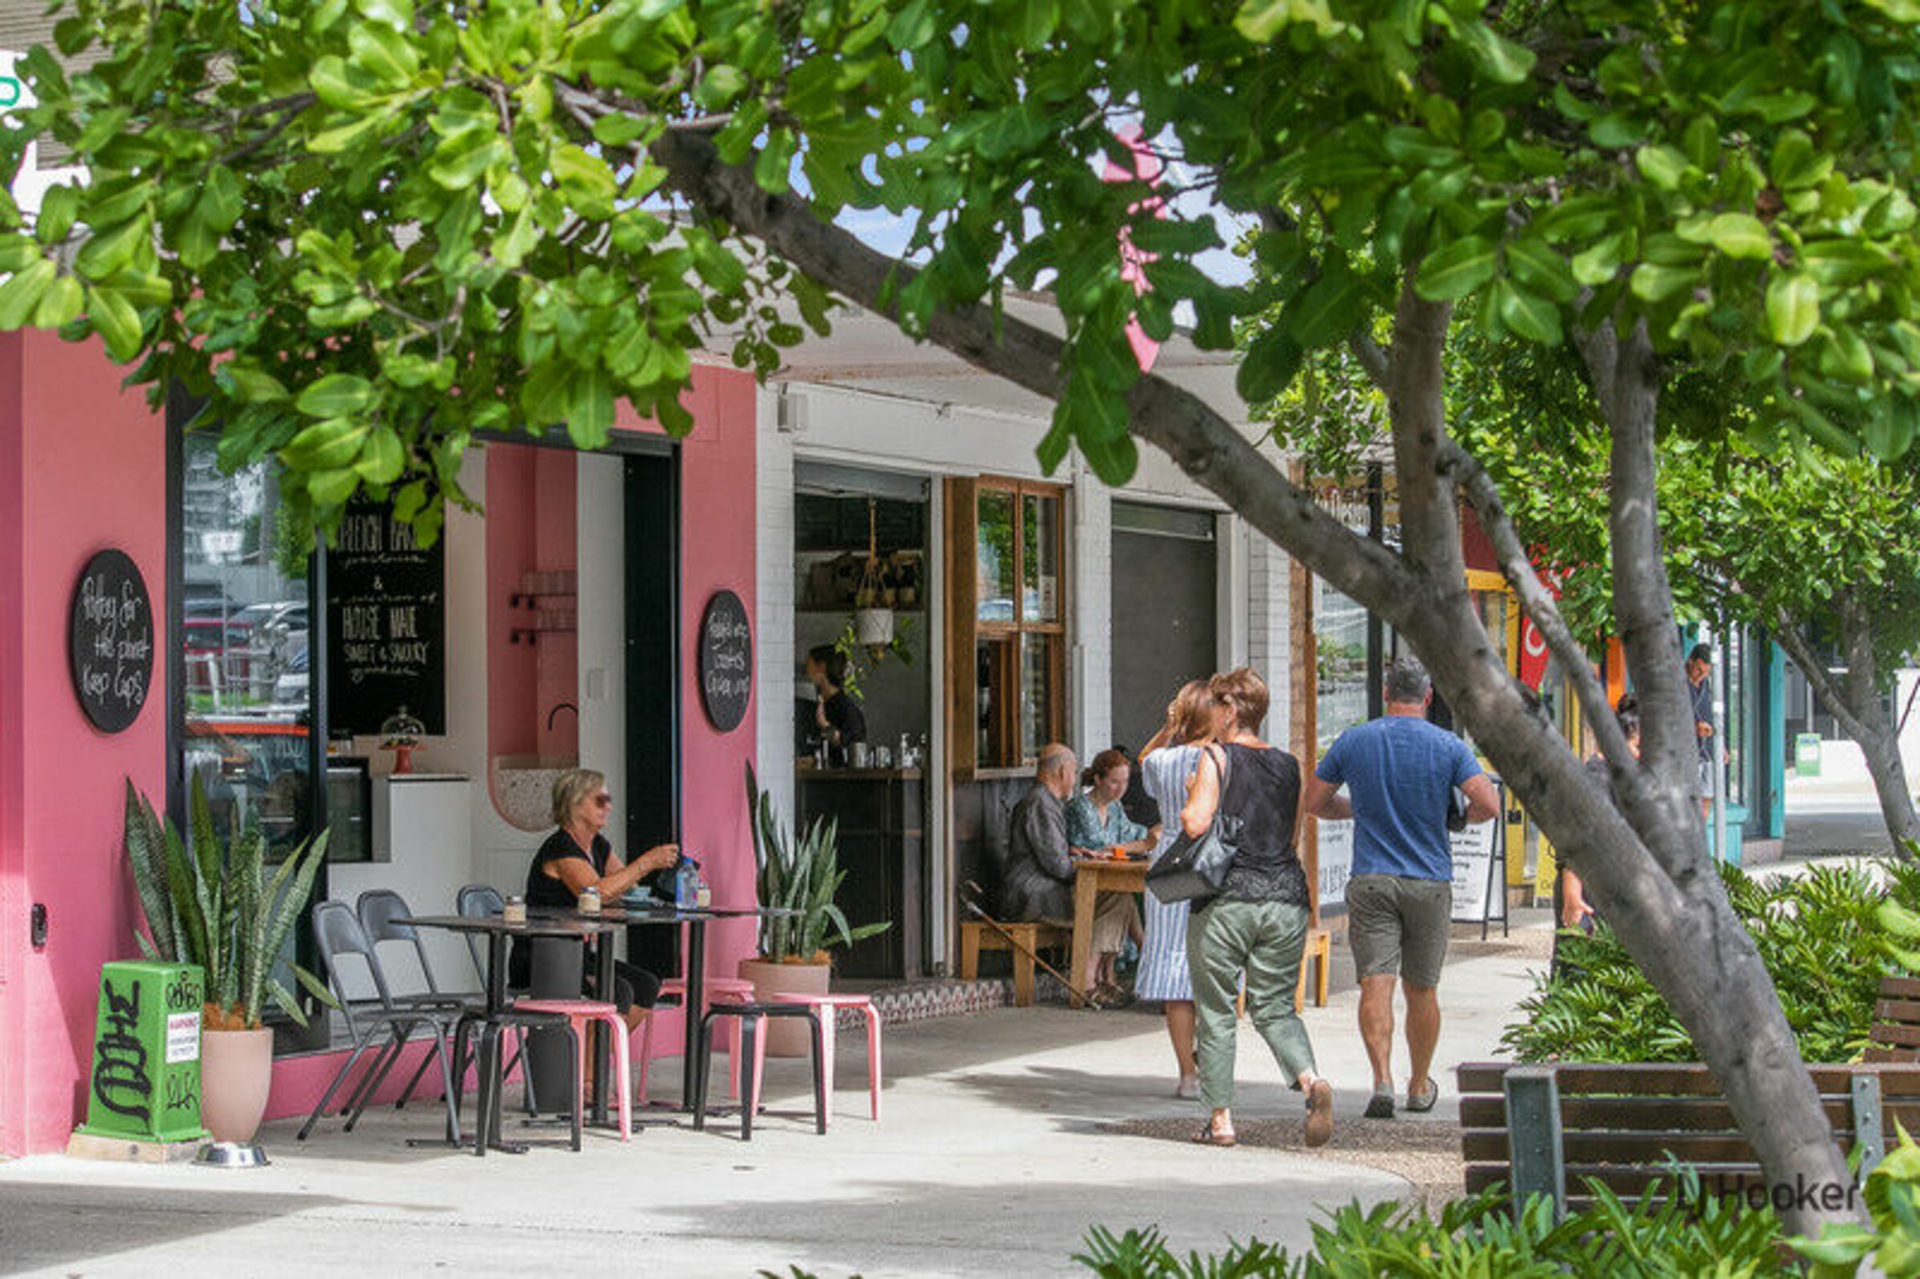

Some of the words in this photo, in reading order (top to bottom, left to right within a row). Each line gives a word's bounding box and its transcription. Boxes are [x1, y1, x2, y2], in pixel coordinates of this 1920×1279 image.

[373, 575, 383, 591] &
[343, 604, 380, 640] HOUSE
[390, 605, 418, 639] MADE
